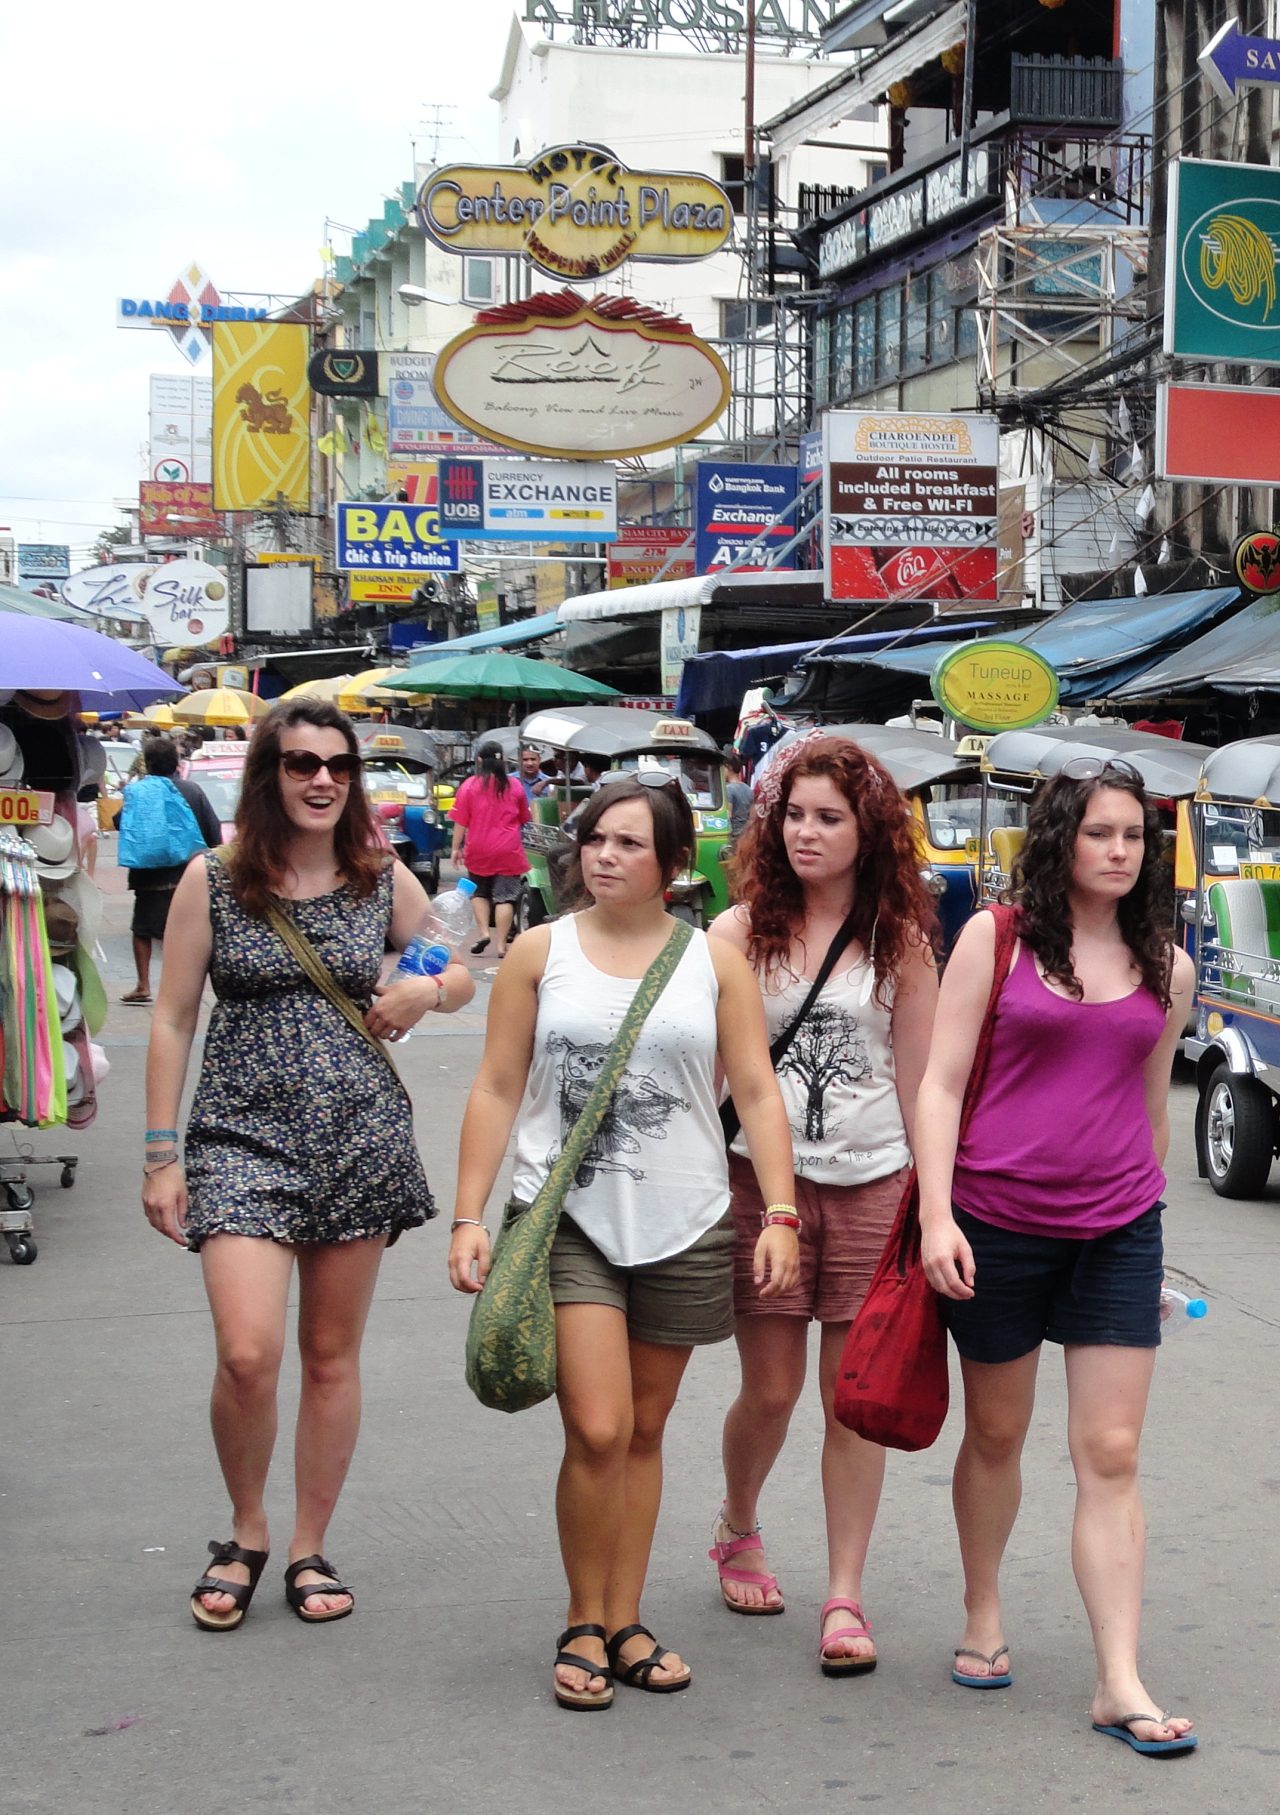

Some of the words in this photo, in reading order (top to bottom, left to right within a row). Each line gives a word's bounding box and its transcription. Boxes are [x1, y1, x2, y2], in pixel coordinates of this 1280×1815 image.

[427, 180, 545, 236] Center
[549, 183, 631, 229] Point
[639, 186, 725, 230] Plaza
[121, 298, 189, 320] DANG
[869, 431, 957, 442] CHAROENDEE
[452, 443, 513, 453] INFORMA
[869, 440, 917, 450] BOUTIQUE
[920, 443, 957, 451] HOSTEL
[856, 454, 895, 462] Outdoor
[899, 455, 923, 463] Patio
[926, 455, 978, 464] Restaurant
[488, 472, 544, 482] CURRENCY
[876, 466, 900, 480] All
[904, 469, 959, 481] rooms
[489, 484, 613, 503] EXCHANGE
[725, 483, 763, 497] Bangkok
[763, 484, 786, 494] Bank
[838, 481, 911, 495] included
[915, 482, 996, 497] breakfast
[444, 503, 481, 517] UOB
[863, 498, 878, 511] &
[883, 498, 923, 511] Free
[927, 499, 973, 512] WI-FI
[345, 508, 446, 545] BAG
[345, 549, 370, 564] Chic
[371, 551, 383, 564] &
[384, 549, 408, 568] Trip
[410, 551, 452, 567] Station
[153, 580, 206, 608] Silk
[378, 584, 404, 593] INN
[969, 663, 1033, 683] Tuneup
[967, 691, 1031, 702] MASSAGE
[662, 725, 690, 736] TAXI
[829, 1155, 840, 1165] a
[844, 1148, 874, 1164] Time
